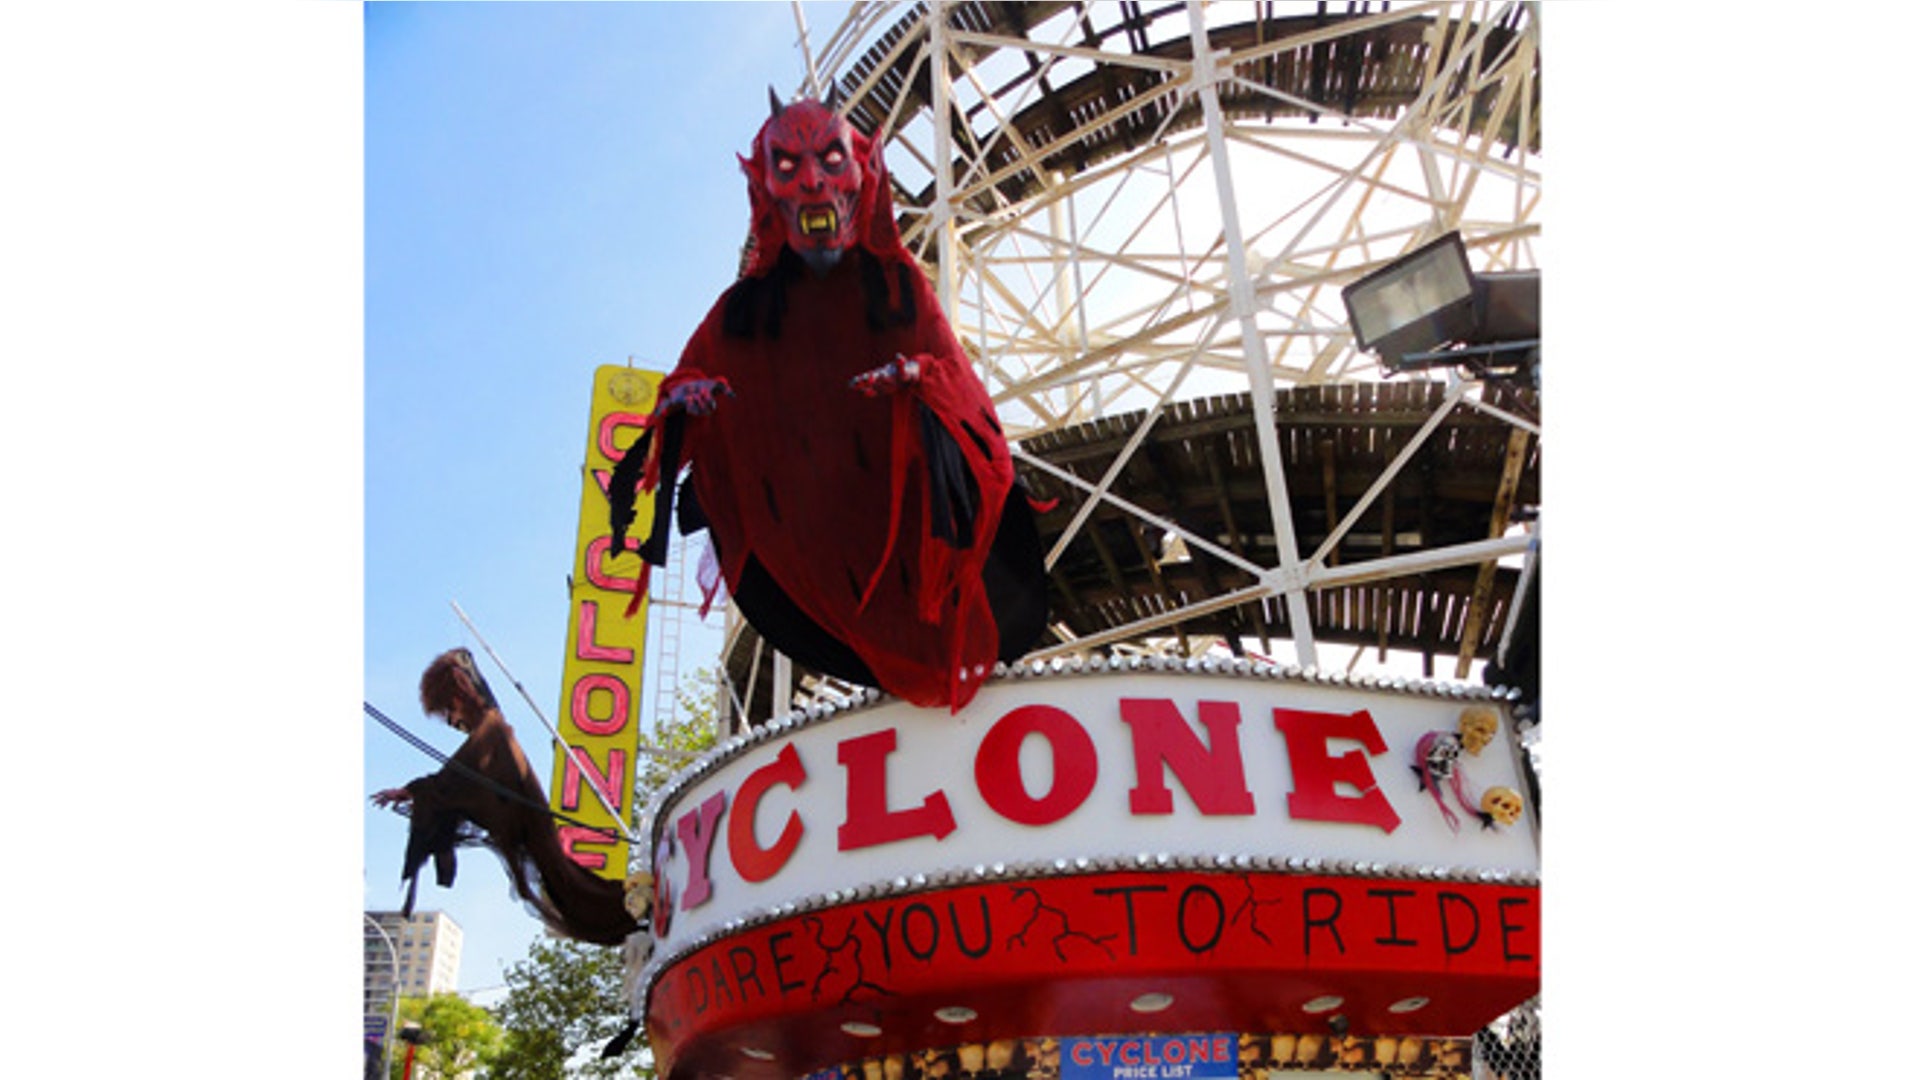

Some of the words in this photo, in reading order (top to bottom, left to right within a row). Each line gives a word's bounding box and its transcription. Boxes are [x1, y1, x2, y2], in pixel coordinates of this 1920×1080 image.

[653, 697, 1402, 939] CYCLONE
[687, 931, 806, 1016] DARE
[864, 896, 992, 971] YOU
[1094, 884, 1226, 955] TO
[1302, 887, 1533, 962] RIDE
[1071, 1038, 1230, 1067] CYCLONE
[1113, 1066, 1158, 1079] PRICE
[1162, 1065, 1193, 1078] LIST
